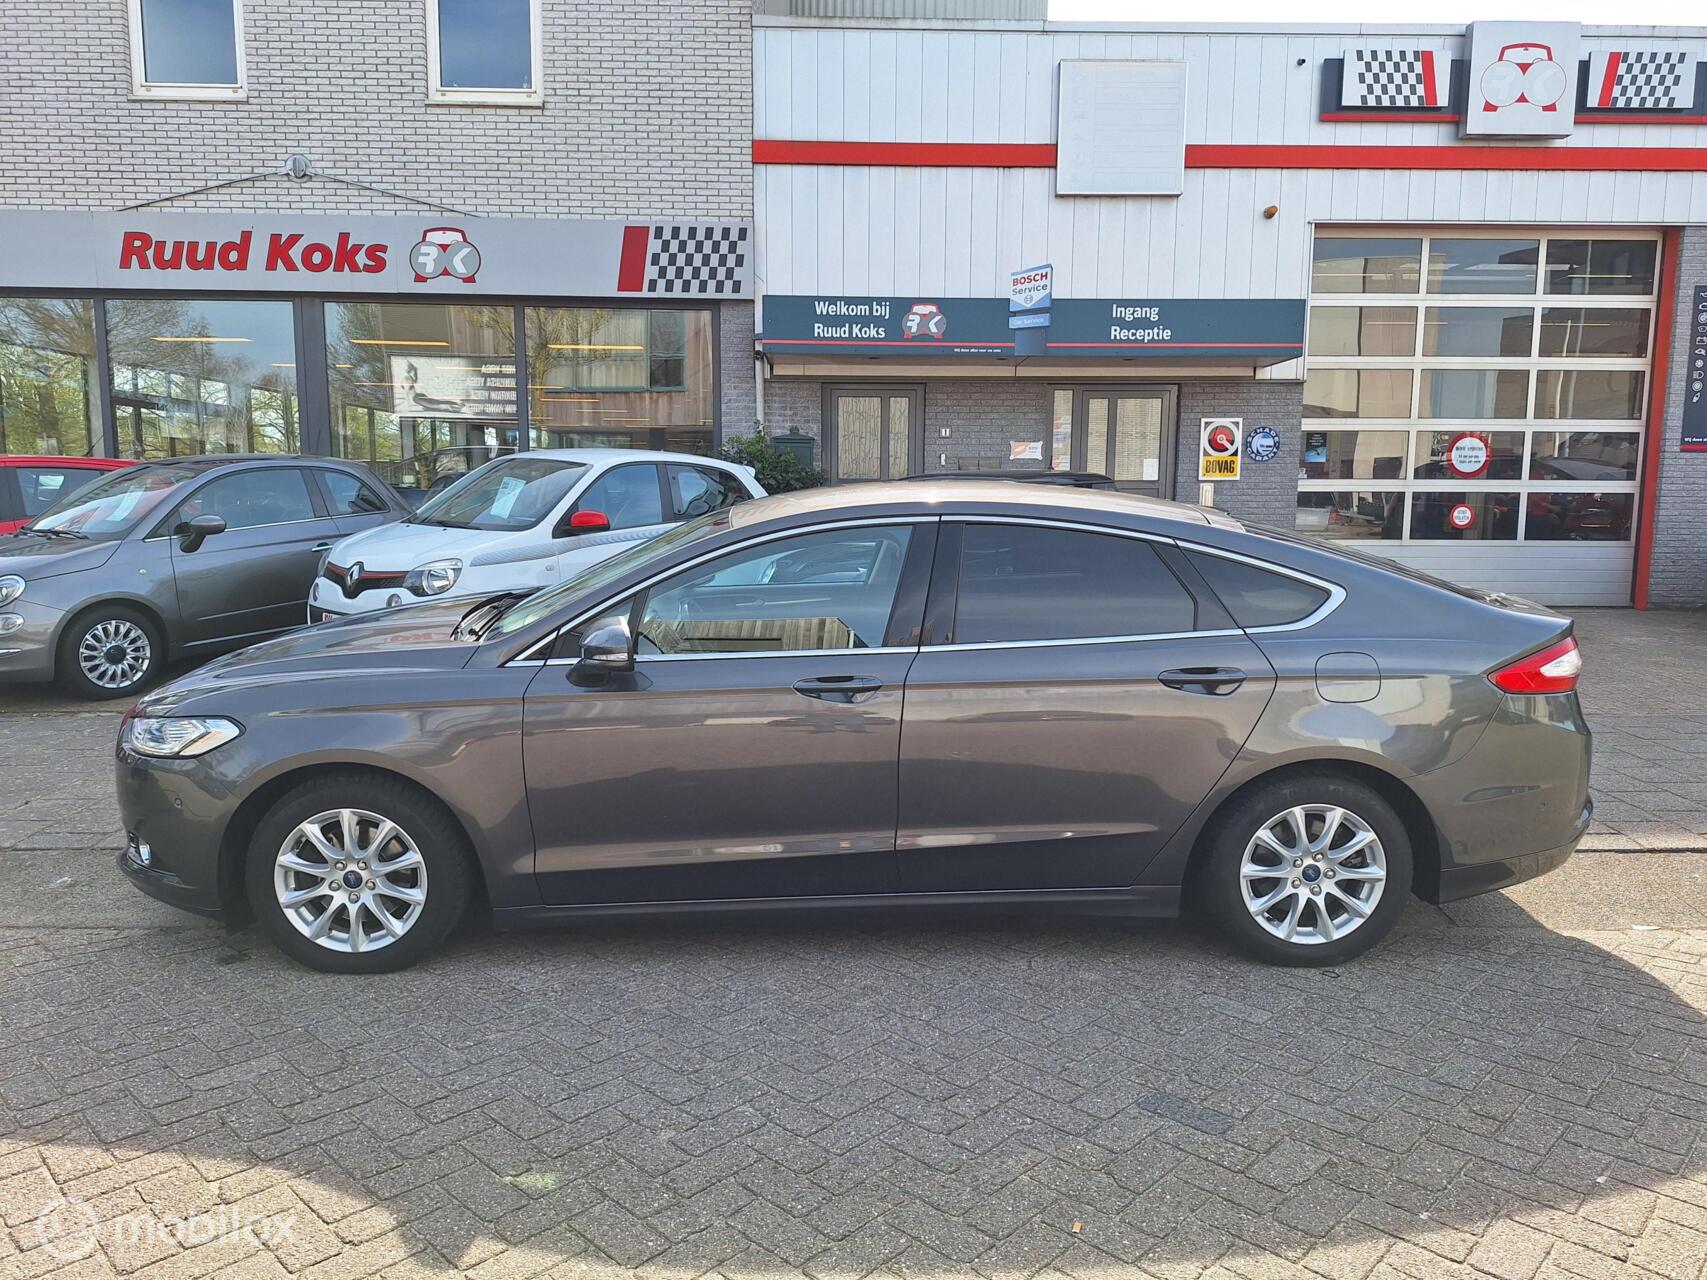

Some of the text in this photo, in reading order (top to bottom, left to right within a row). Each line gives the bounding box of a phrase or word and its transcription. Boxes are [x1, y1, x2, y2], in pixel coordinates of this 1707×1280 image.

[119, 231, 388, 273] Ruud Koks
[1012, 271, 1048, 287] BOSCH
[1012, 283, 1048, 296] Service
[814, 301, 890, 319] Welkom bij
[1112, 303, 1160, 321] Ingang
[1023, 317, 1044, 325] Service
[814, 323, 886, 338] Ruud Koks
[1110, 325, 1172, 343] Receptie
[1246, 427, 1279, 442] SCHADE
[1246, 447, 1278, 461] GARANT
[1205, 459, 1235, 474] BOVAG
